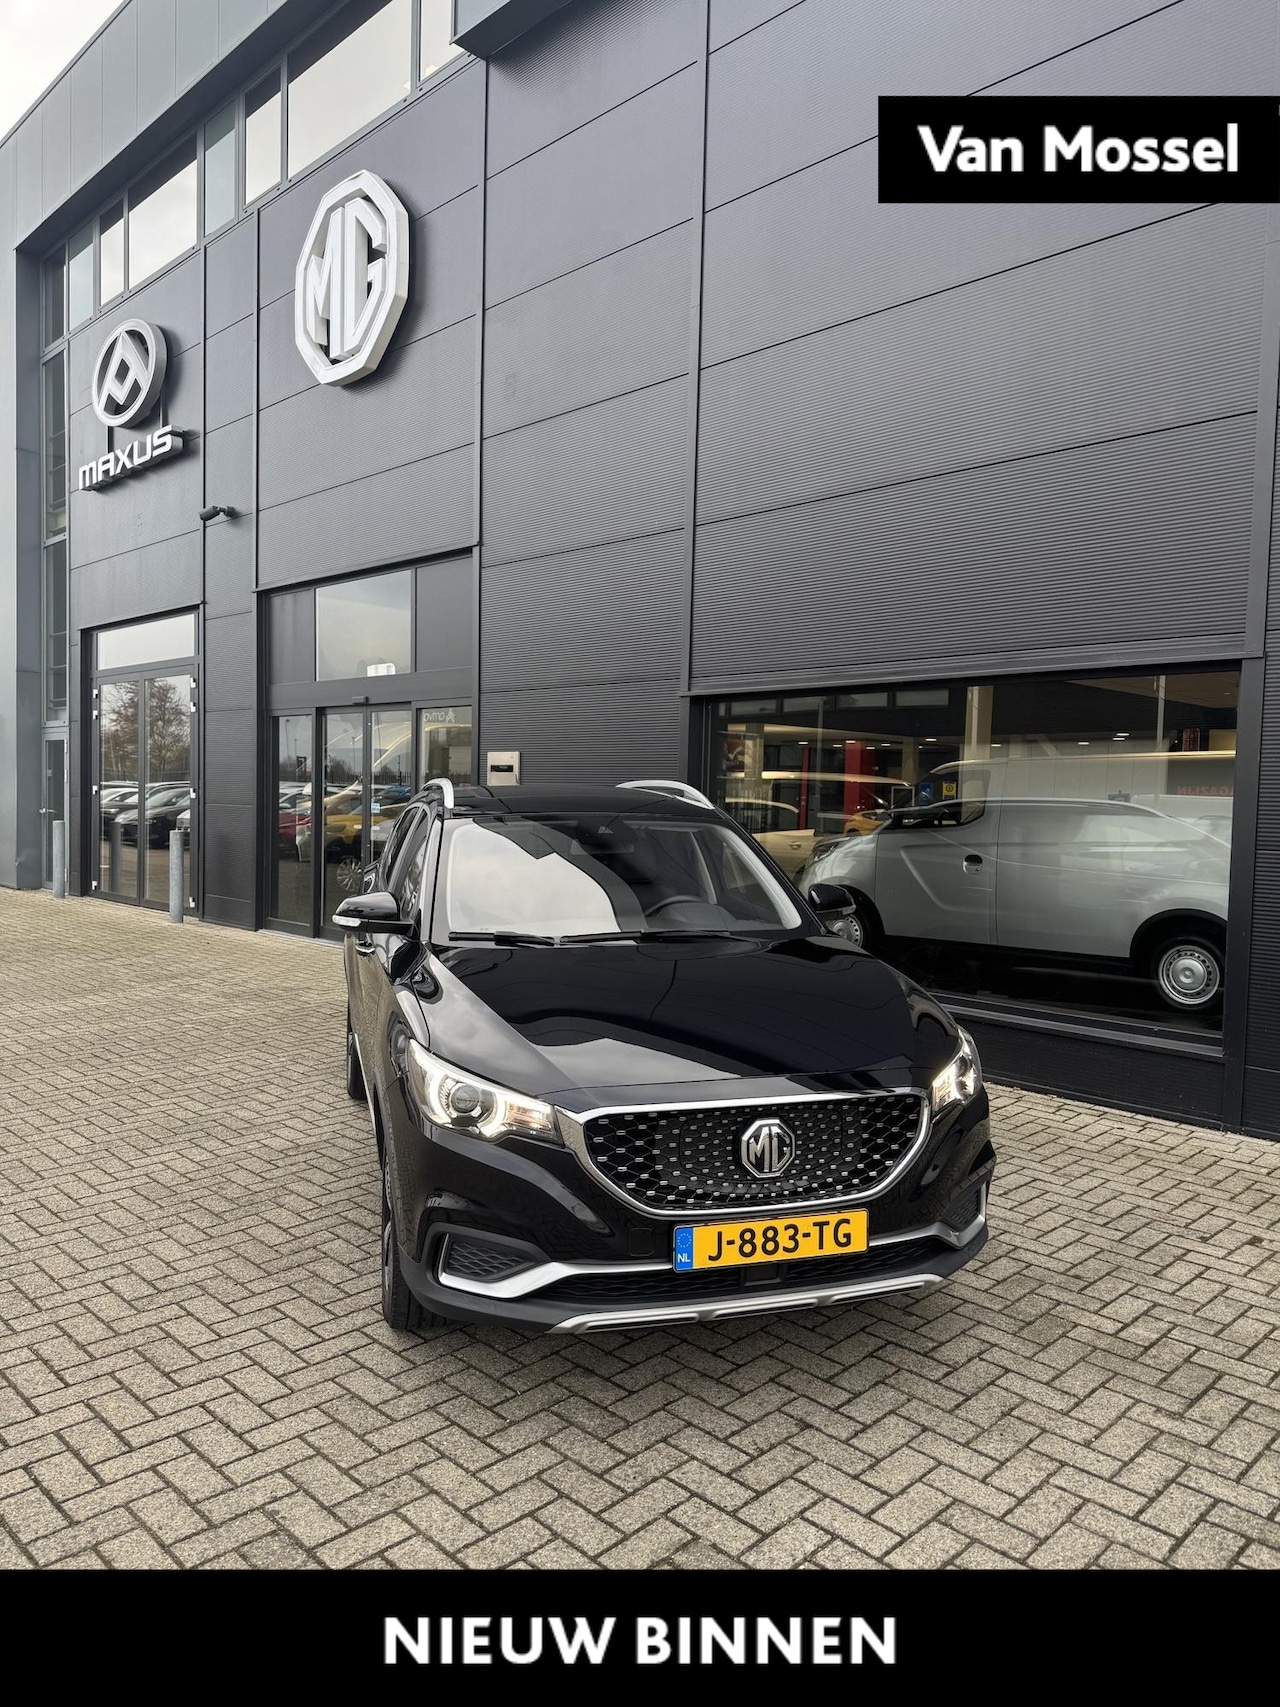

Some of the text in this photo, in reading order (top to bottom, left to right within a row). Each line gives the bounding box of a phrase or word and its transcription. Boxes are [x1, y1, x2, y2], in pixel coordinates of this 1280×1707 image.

[304, 193, 389, 361] MG
[79, 424, 173, 490] MAXUS
[748, 1125, 791, 1172] MG
[677, 1253, 691, 1263] NL
[708, 1218, 852, 1262] J-883-TG
